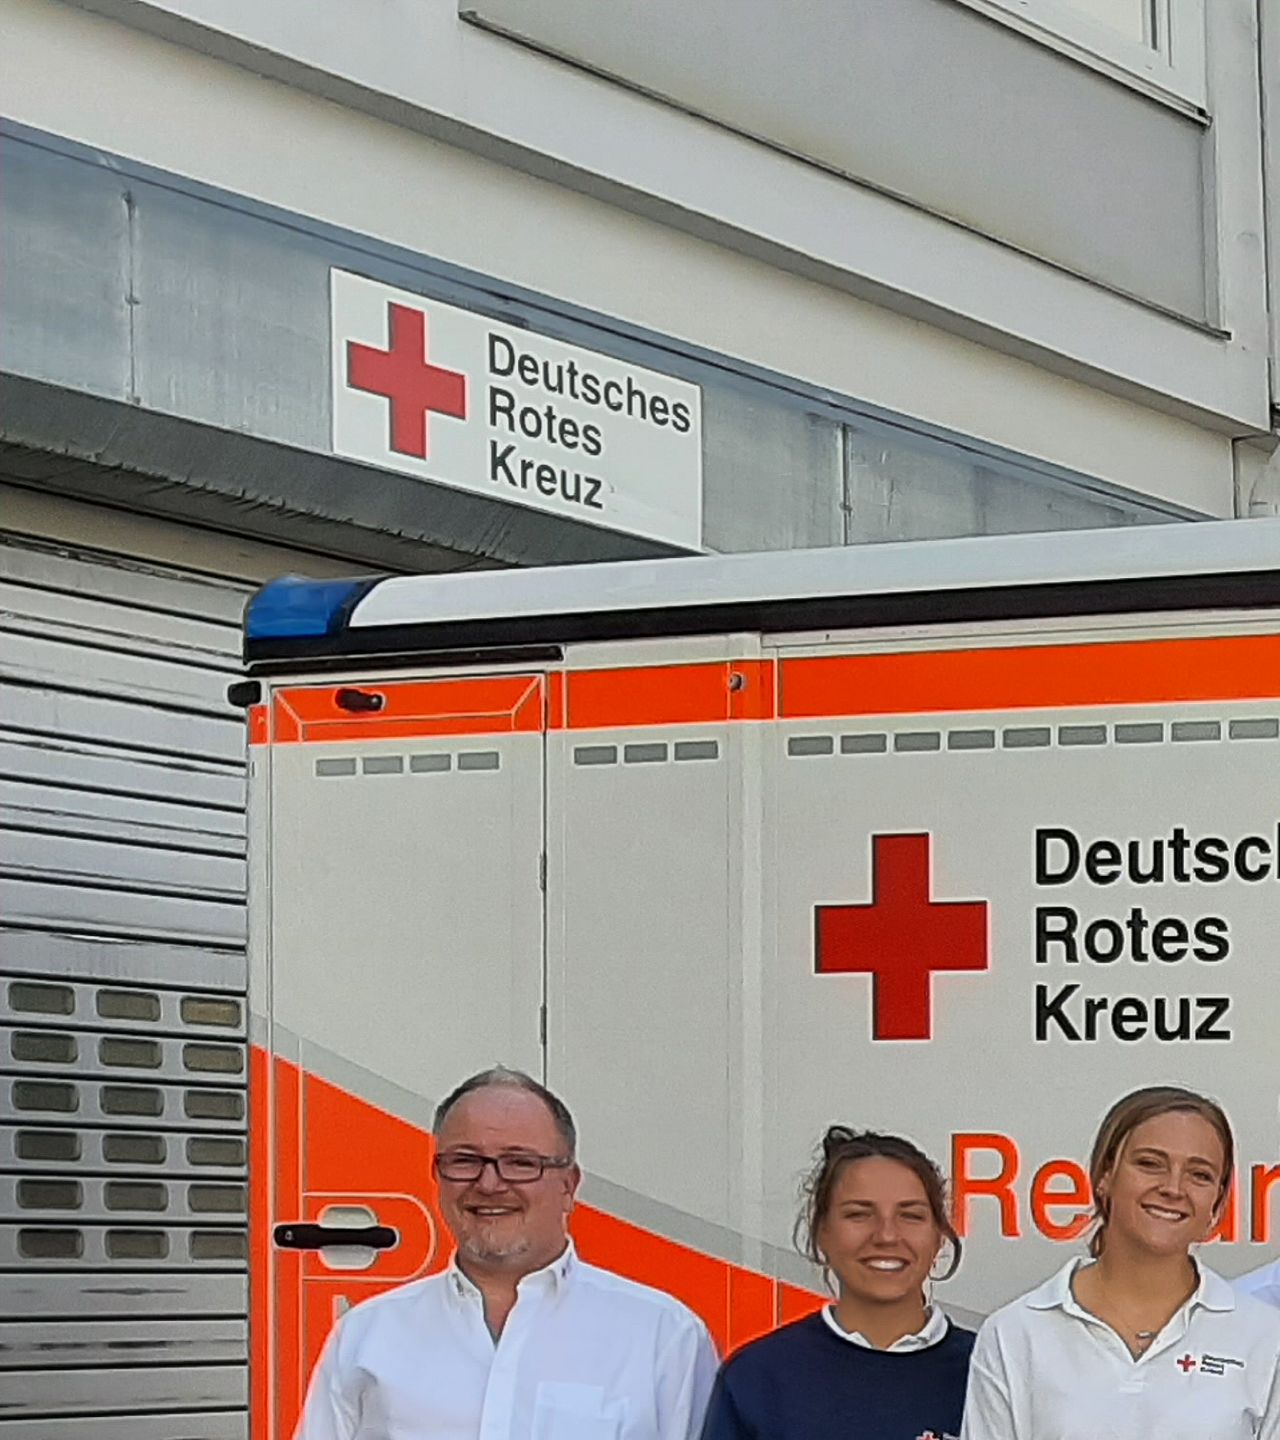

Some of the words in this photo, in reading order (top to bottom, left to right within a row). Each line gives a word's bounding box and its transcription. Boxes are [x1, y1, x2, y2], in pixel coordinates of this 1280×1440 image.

[488, 332, 692, 433] Deutsches
[489, 385, 603, 456] Rotes
[490, 440, 604, 510] Kreuz
[1036, 906, 1230, 964] Rotes
[1036, 984, 1232, 1042] Kreuz
